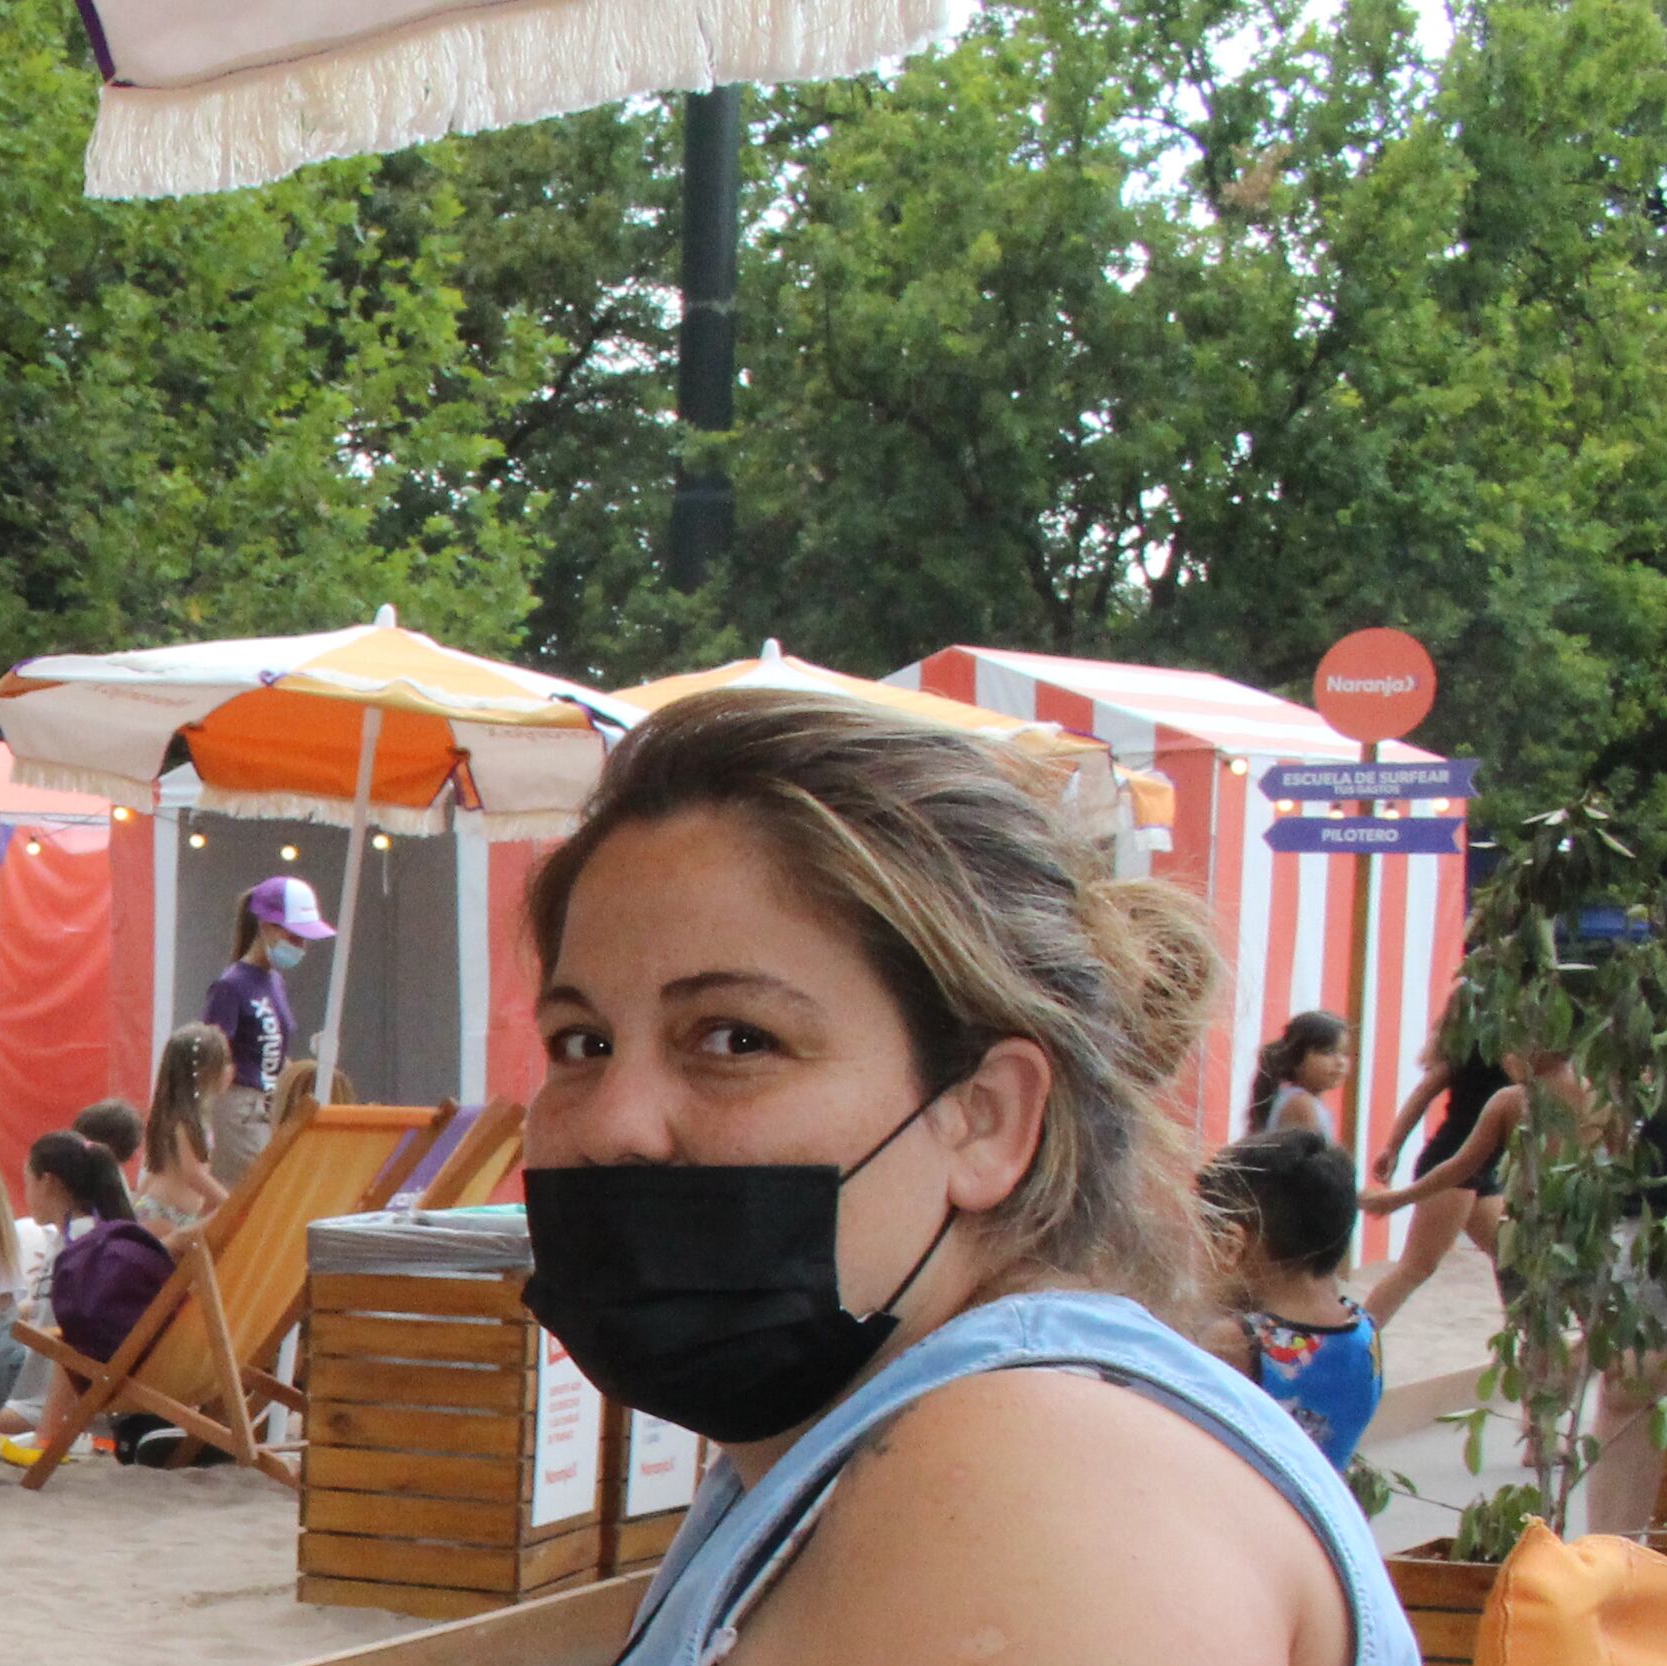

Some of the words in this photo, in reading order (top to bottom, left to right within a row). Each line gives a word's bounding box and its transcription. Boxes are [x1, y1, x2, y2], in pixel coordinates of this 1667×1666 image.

[1283, 772, 1351, 786] ESCUELA
[1354, 771, 1376, 785] DE
[1379, 770, 1450, 785] SURFEAR
[1322, 829, 1399, 842] PILOTERO
